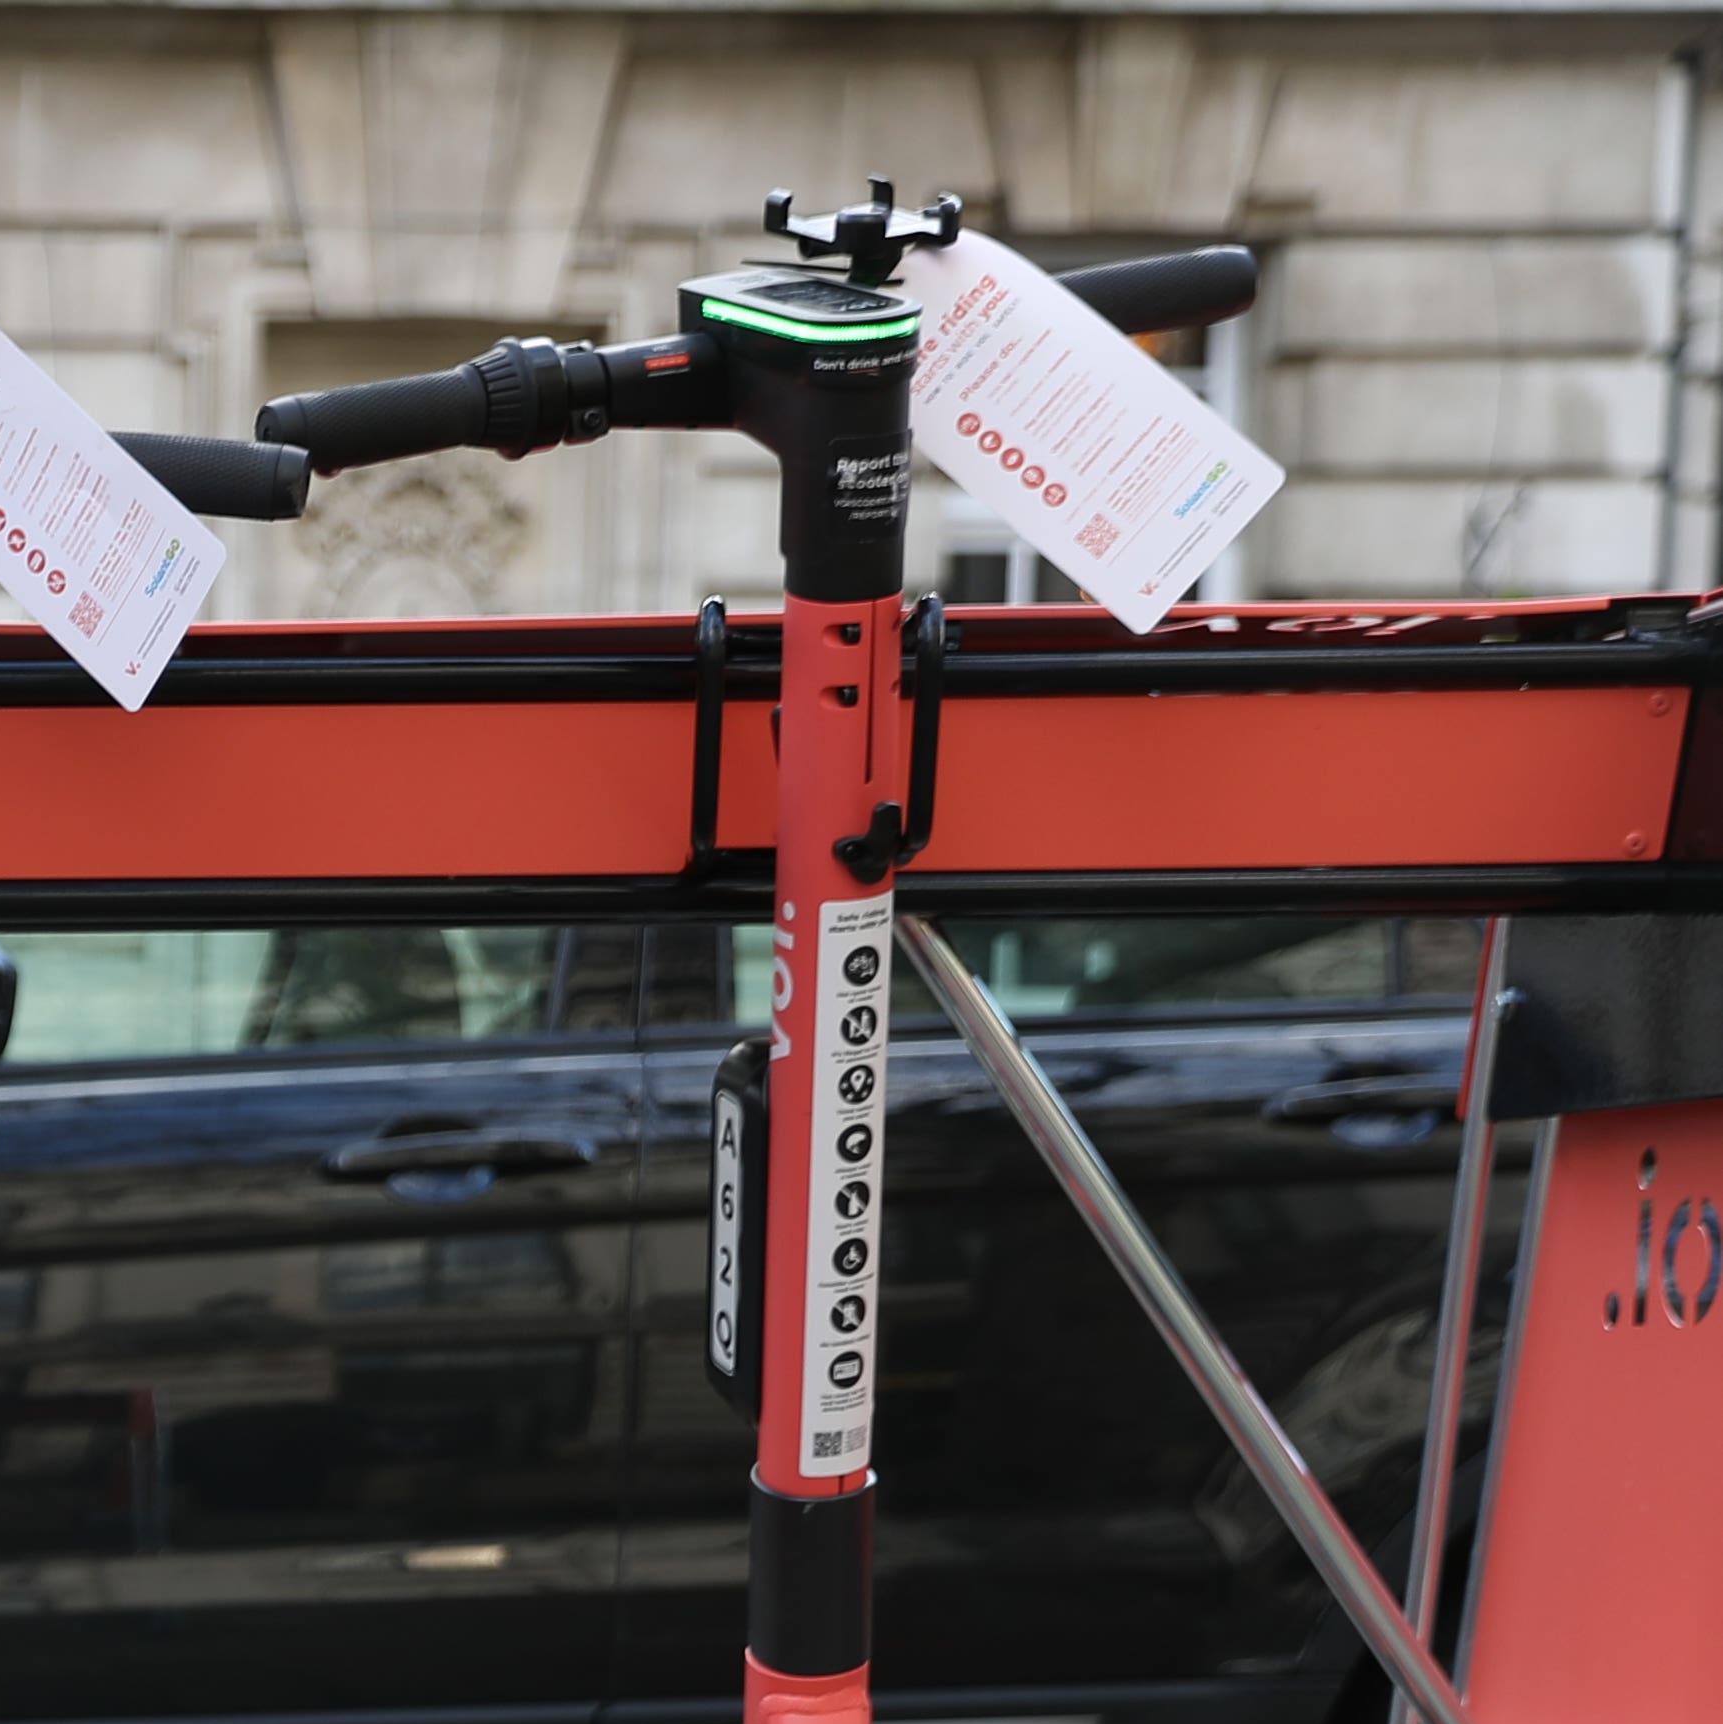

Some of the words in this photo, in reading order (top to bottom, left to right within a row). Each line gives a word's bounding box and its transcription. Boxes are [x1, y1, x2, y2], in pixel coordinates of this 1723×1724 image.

[938, 275, 997, 336] riding
[814, 358, 845, 370] Don't
[847, 355, 879, 370] drink
[959, 361, 999, 402] Please
[836, 911, 859, 924] Safe
